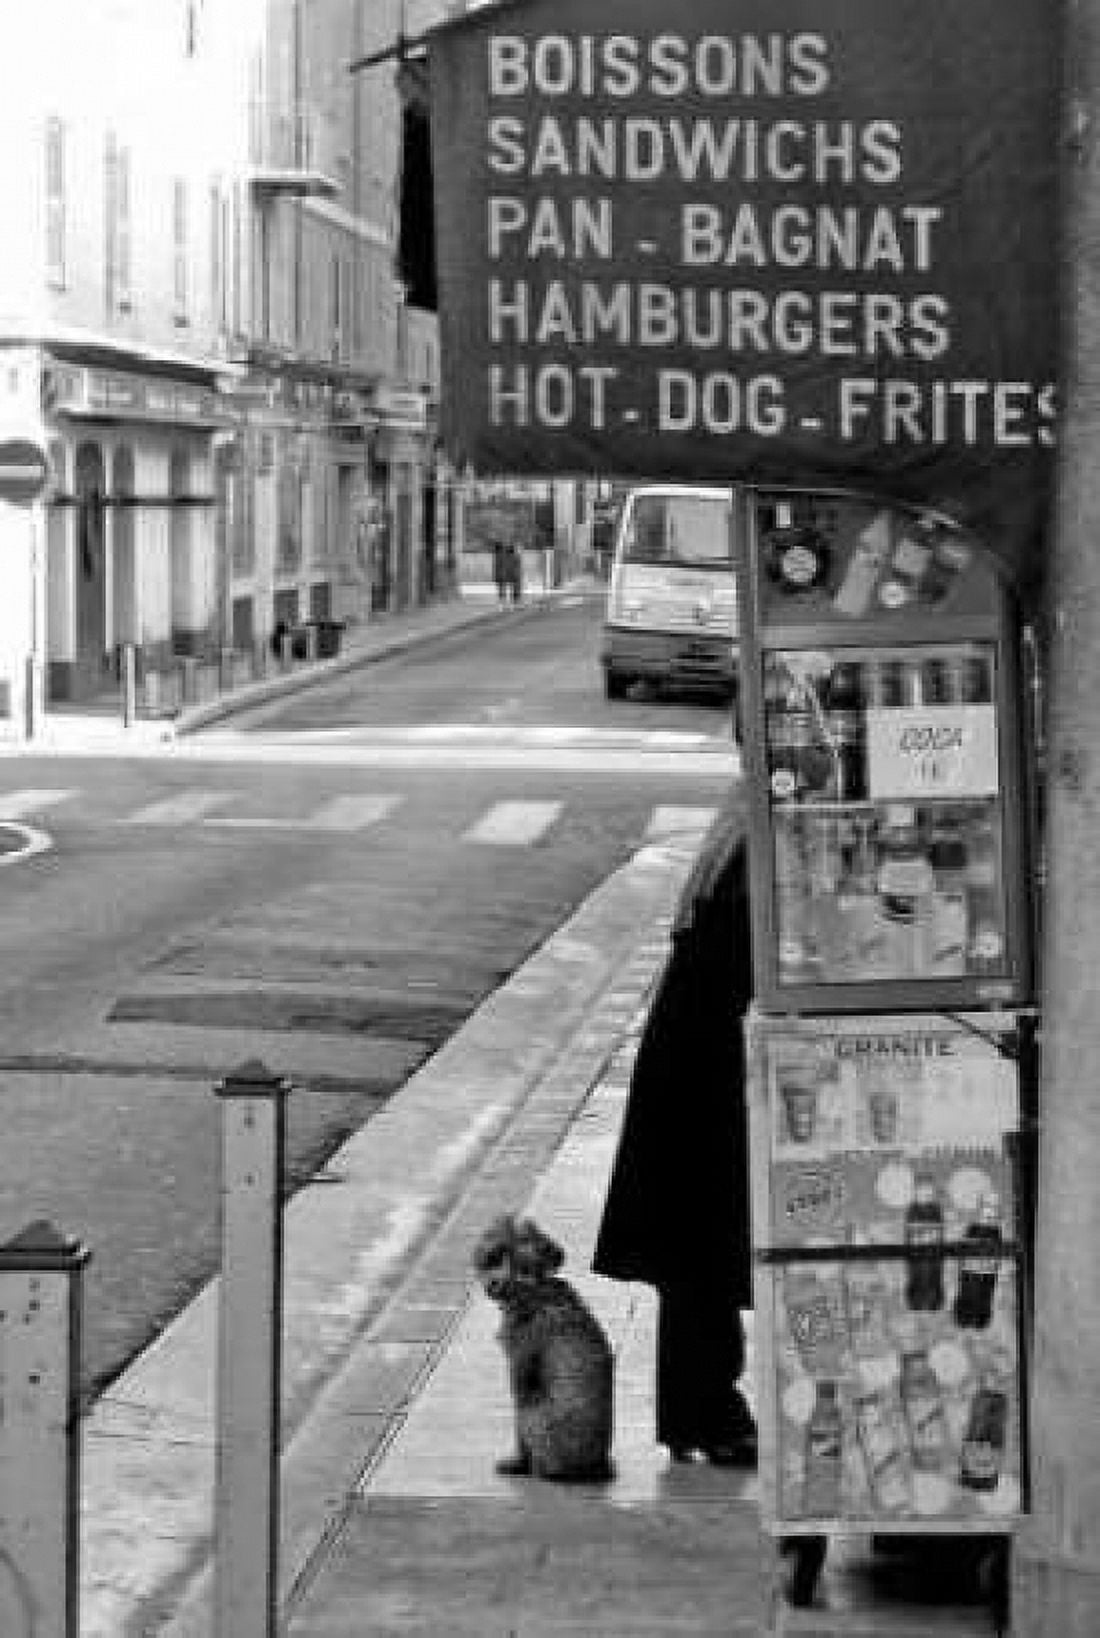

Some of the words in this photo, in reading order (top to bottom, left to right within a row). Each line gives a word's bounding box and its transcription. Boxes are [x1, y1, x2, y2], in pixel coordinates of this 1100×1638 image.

[487, 32, 830, 96] BOISSONS
[487, 115, 901, 183] SANDWICHS
[487, 195, 613, 259] PAN
[681, 203, 941, 272] BAGNAT
[487, 279, 949, 360] HAMBURGERS
